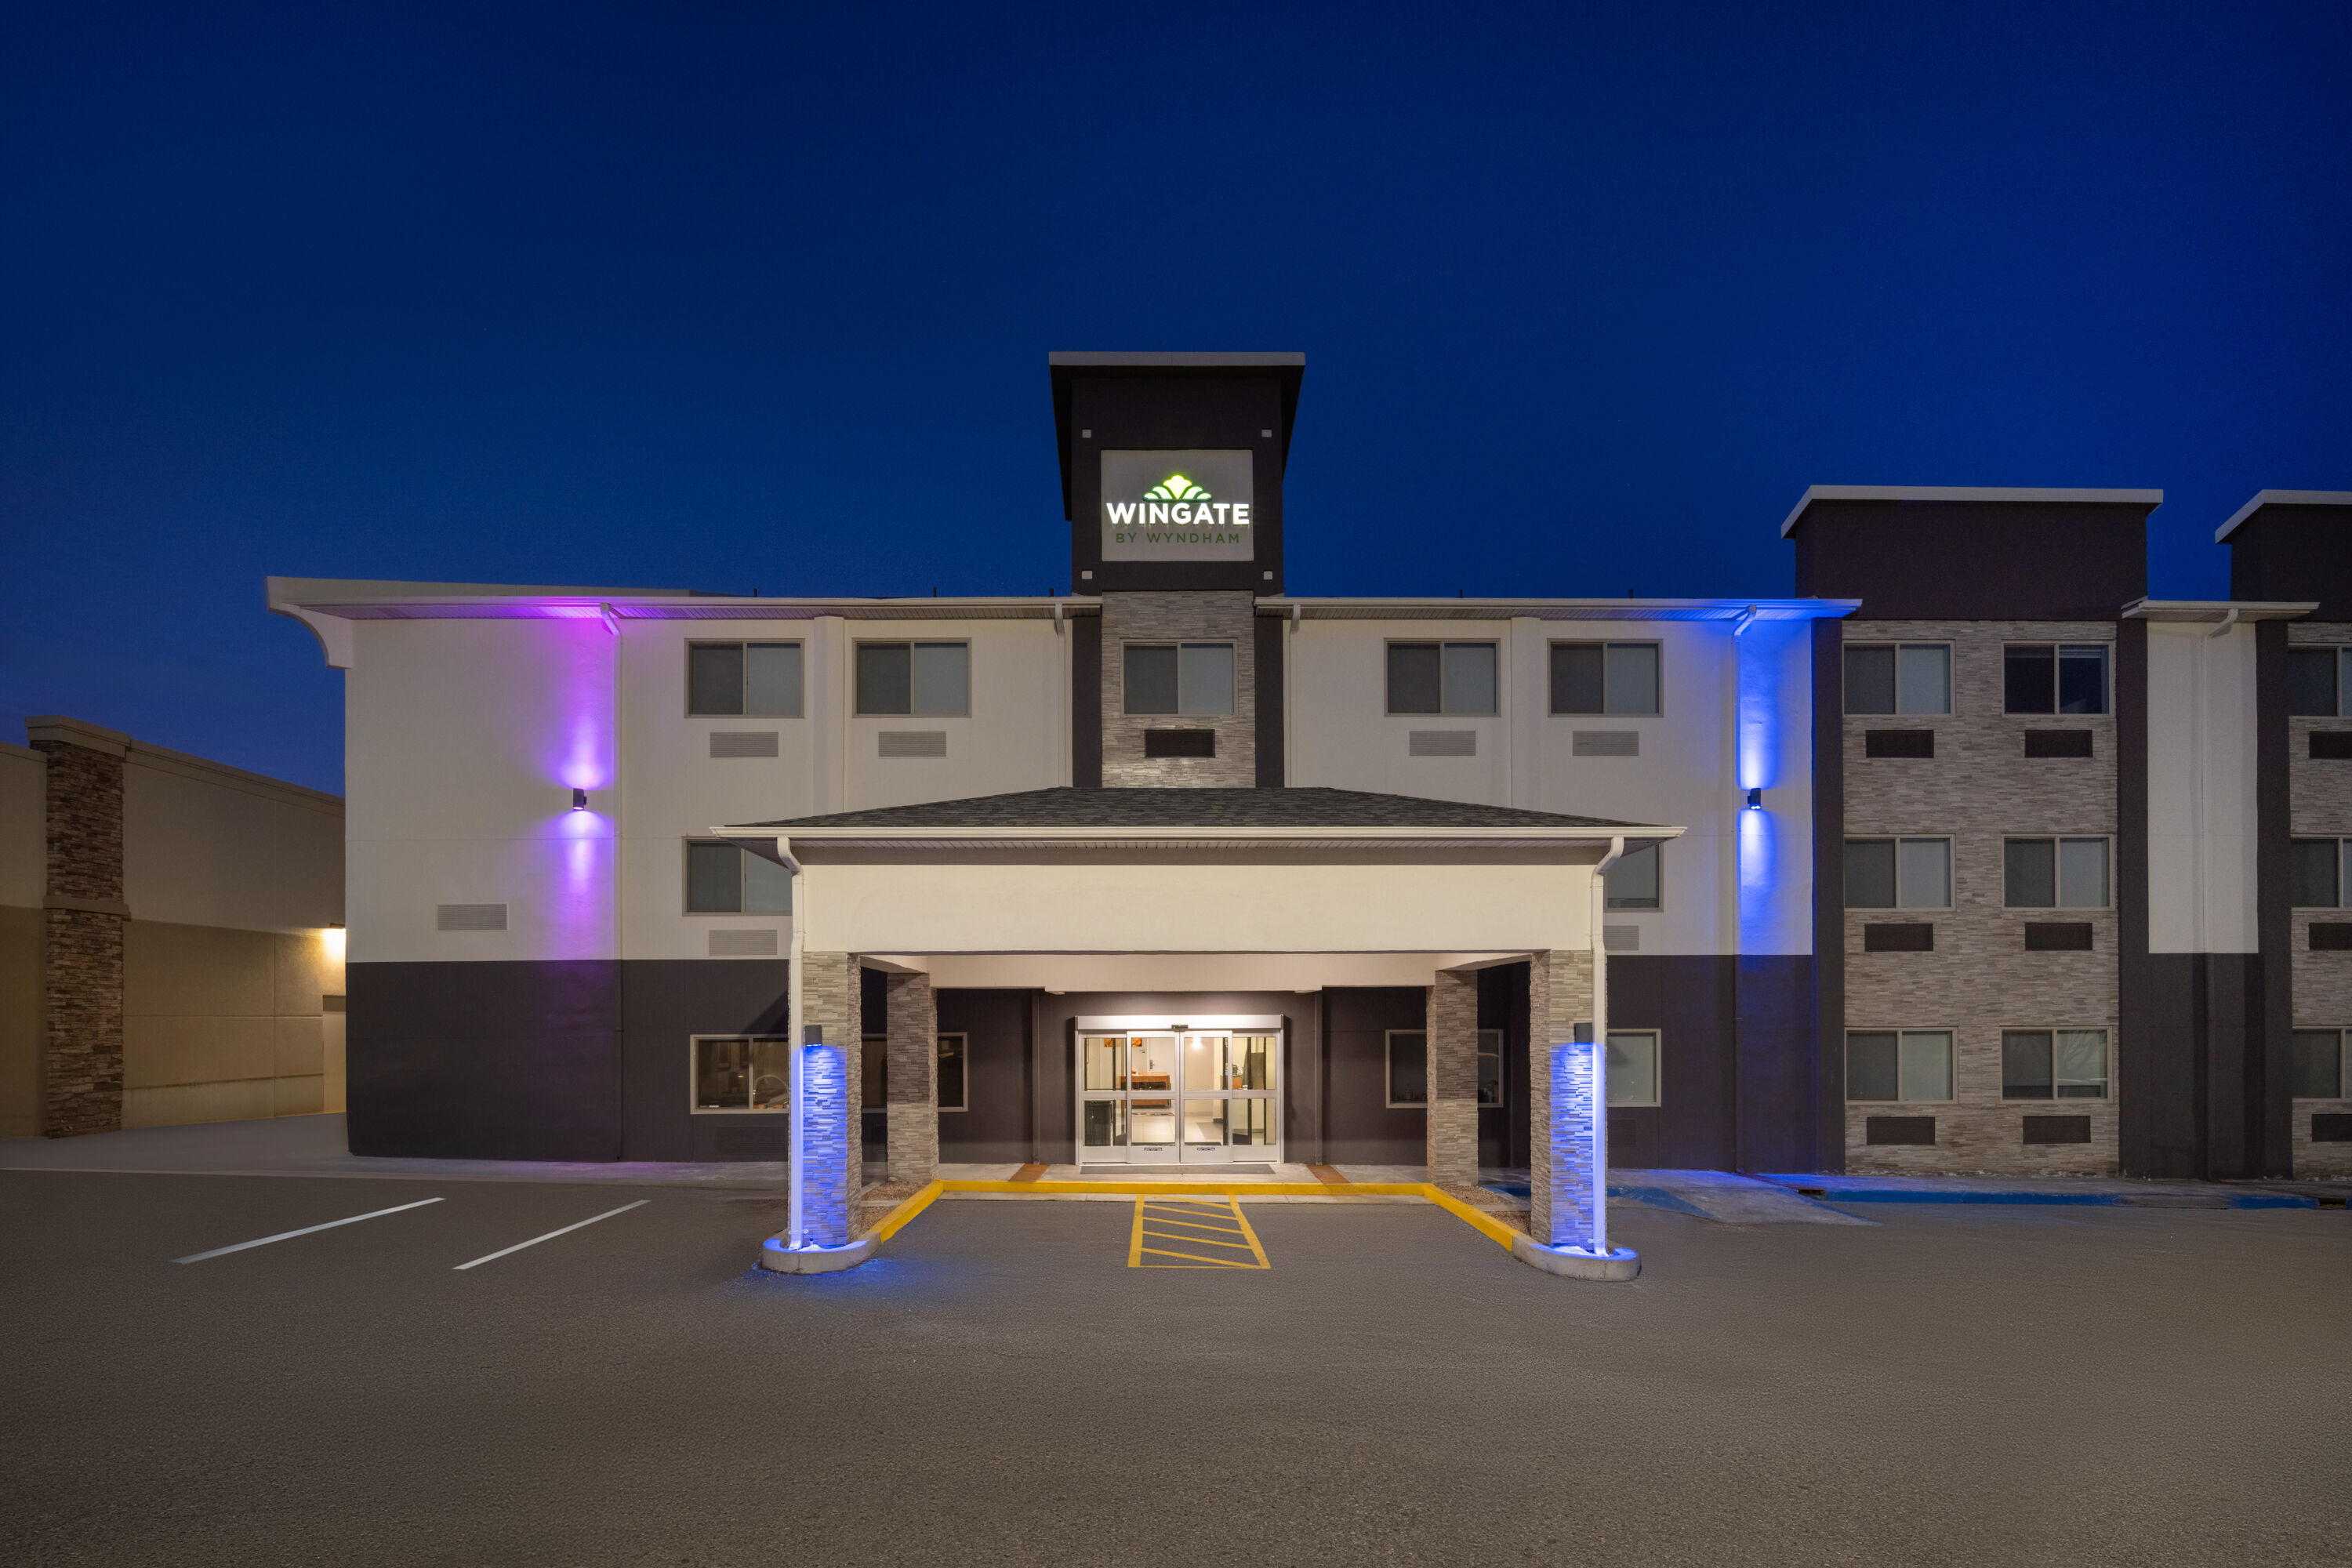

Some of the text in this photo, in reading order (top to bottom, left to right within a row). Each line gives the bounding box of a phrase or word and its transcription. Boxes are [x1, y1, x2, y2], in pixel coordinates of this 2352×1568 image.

[1105, 503, 1250, 524] WINGATE
[1116, 532, 1240, 543] BY WYNDHAM
